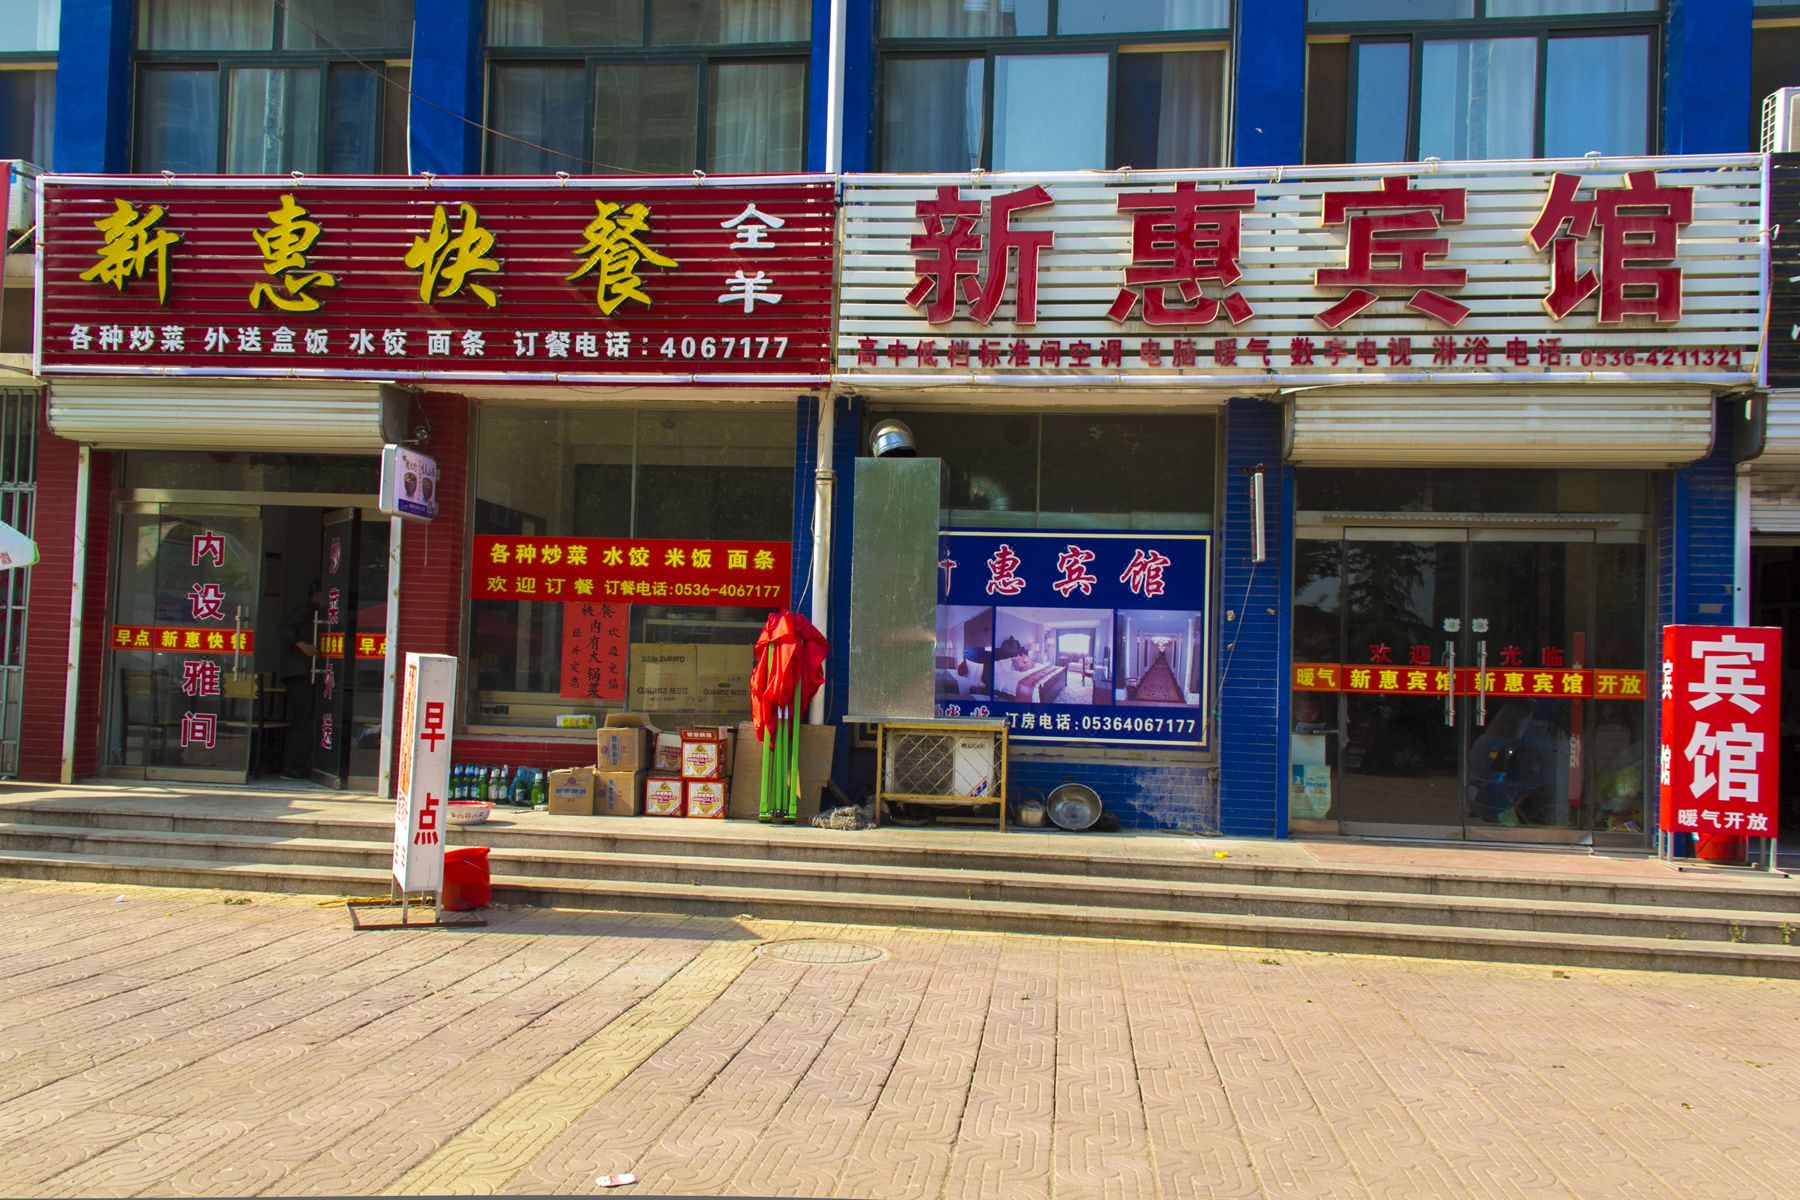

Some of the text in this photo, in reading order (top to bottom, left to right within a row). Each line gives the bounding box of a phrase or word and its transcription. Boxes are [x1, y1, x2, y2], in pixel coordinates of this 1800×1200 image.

[79, 194, 679, 316] 新惠快餐
[718, 203, 785, 313] 全羊
[905, 172, 1694, 327] 新惠宾馆
[69, 323, 185, 352] 各种炒菜
[204, 326, 329, 355] 外送盒饭
[349, 328, 407, 356] 水饺
[427, 329, 486, 357] 面条
[857, 336, 1123, 369] 高中低档标准间空调
[1139, 339, 1198, 368] 电脑
[1215, 338, 1271, 368] 暖气
[1290, 337, 1413, 368] 数字电视
[1433, 337, 1491, 366] 淋浴
[490, 542, 775, 571] 各种炒菜 水饺 米饭 面条
[487, 575, 781, 599] 欢迎订餐 订餐电话:0536-4067177
[115, 629, 248, 651] 早点 新惠快餐
[180, 529, 226, 750] 内设雅间
[1368, 643, 1564, 668] 欢迎 光临
[1296, 666, 1642, 695] 暖气 新惠宾馆 新惠宾馆 开放
[1683, 634, 1766, 803] 宾馆
[413, 701, 446, 846] 早点
[1677, 808, 1769, 832] 暖气开放
